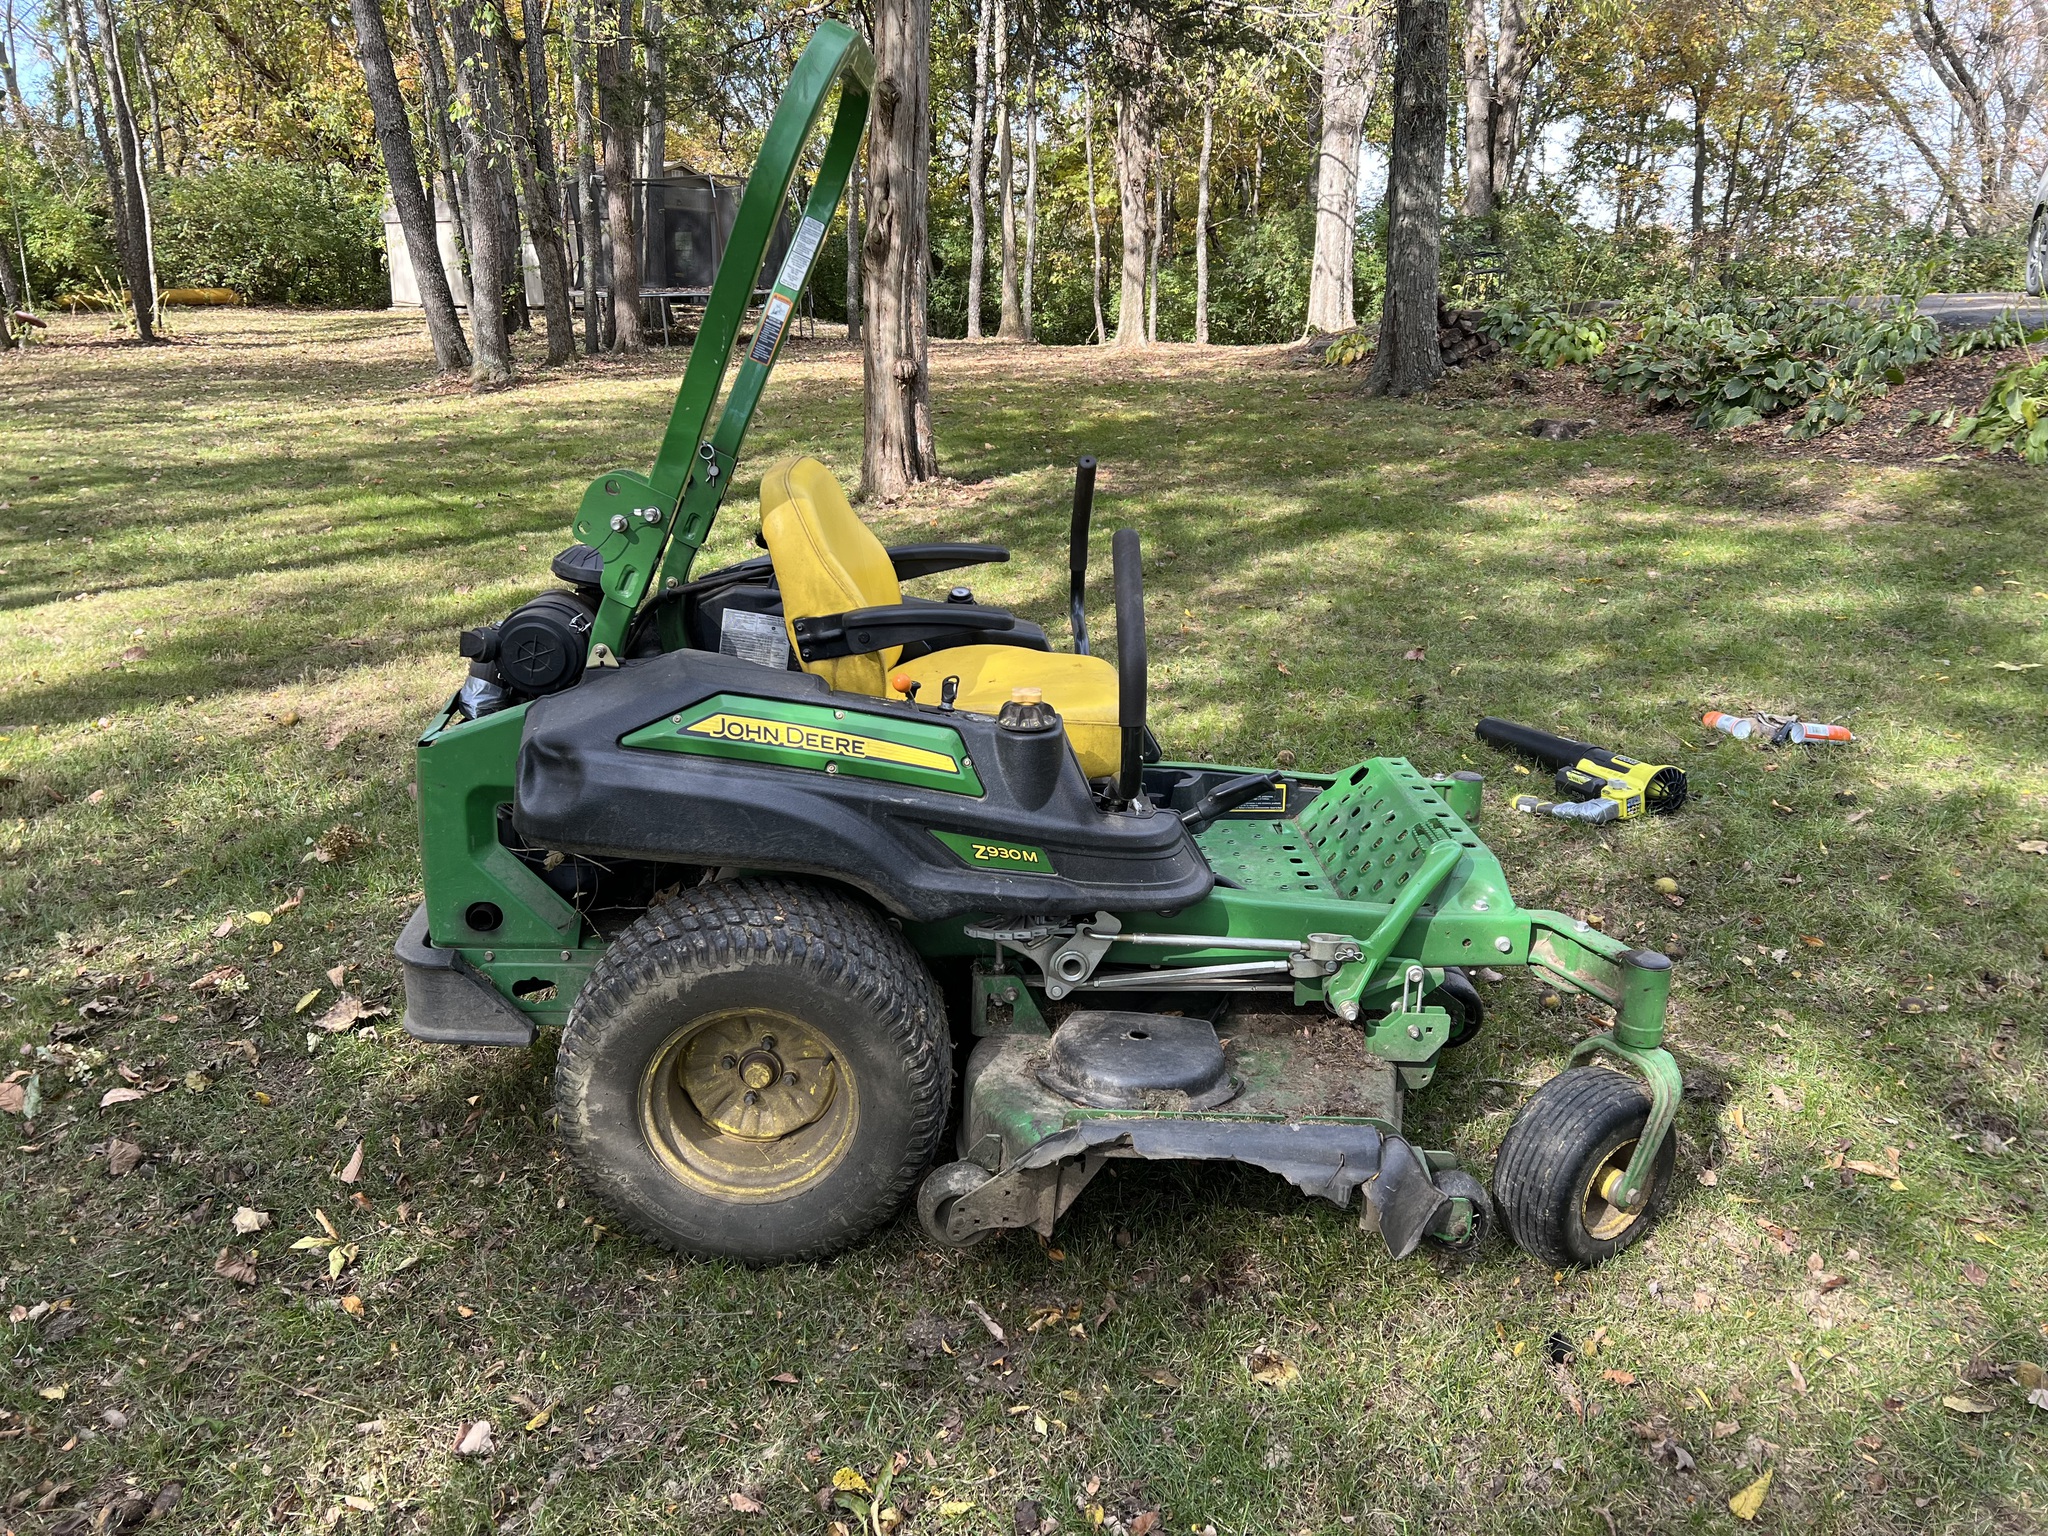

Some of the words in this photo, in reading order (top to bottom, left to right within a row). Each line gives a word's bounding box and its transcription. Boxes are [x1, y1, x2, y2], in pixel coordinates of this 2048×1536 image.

[711, 717, 780, 742] JOHN
[786, 728, 866, 755] DEERE
[971, 844, 1039, 863] Z930M
